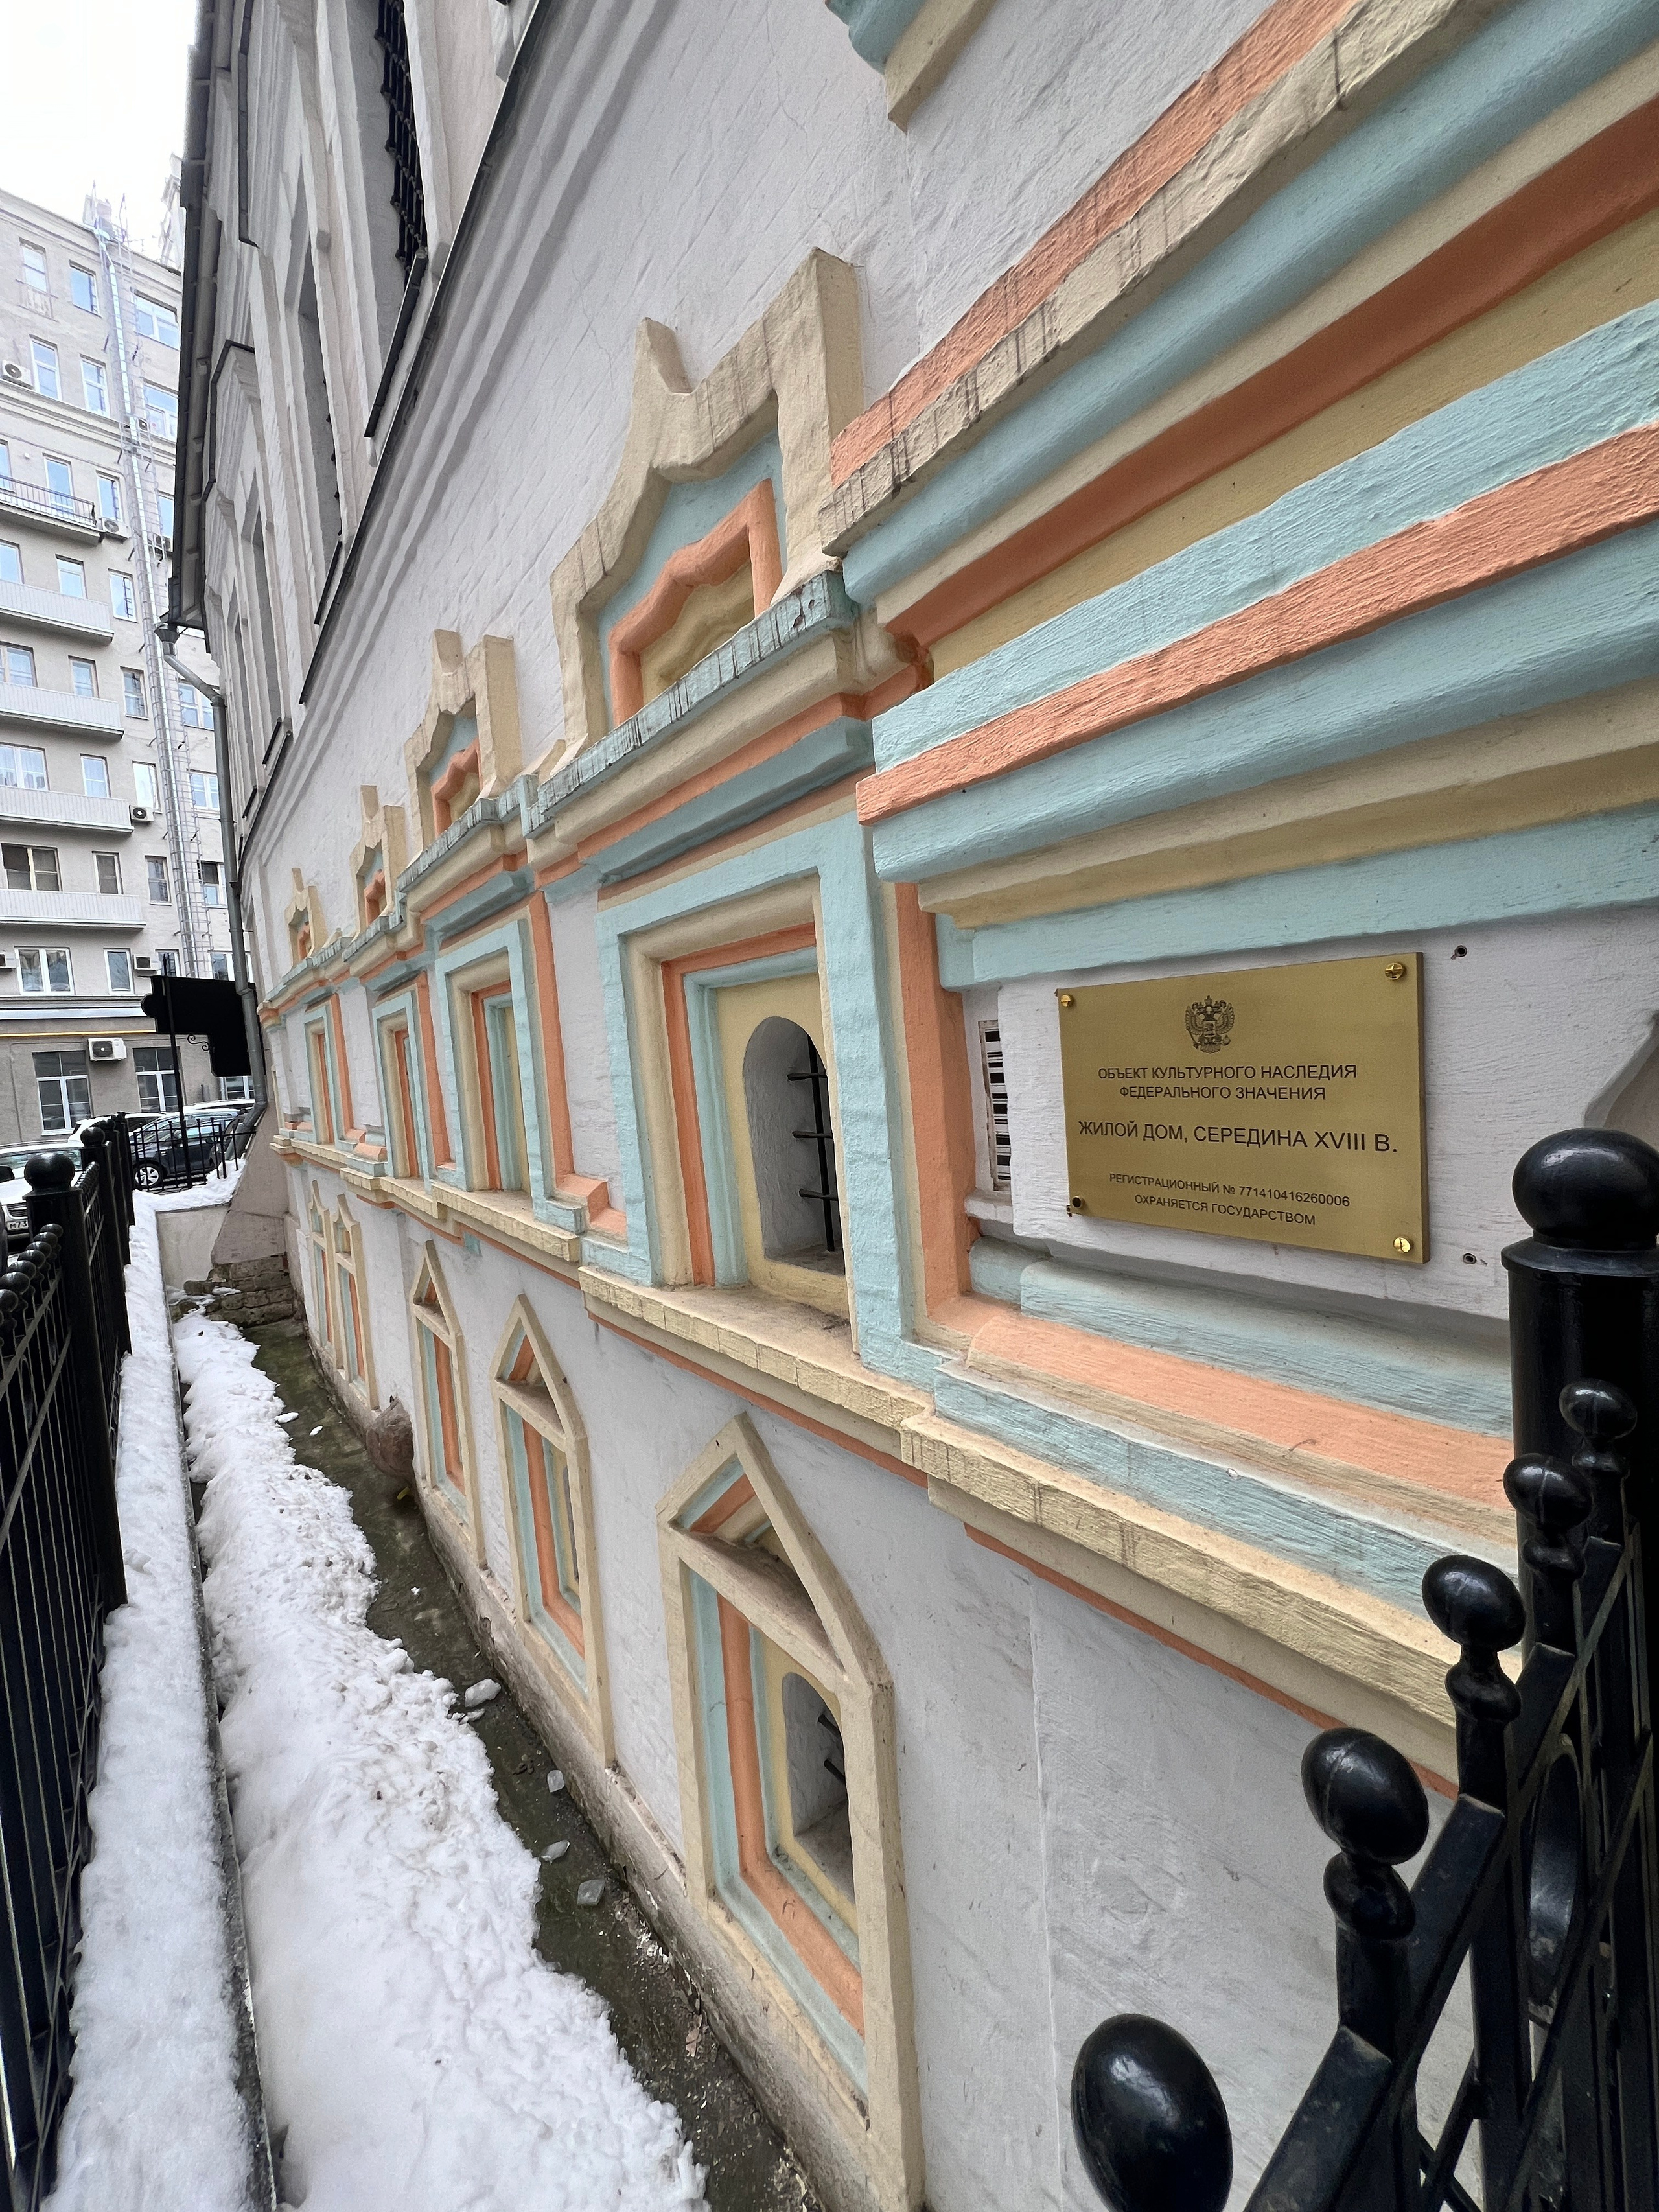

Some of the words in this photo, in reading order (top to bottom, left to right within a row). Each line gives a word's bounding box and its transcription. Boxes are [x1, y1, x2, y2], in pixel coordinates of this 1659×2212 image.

[1098, 1067, 1148, 1079] ОБЪЕКТ
[1152, 1066, 1256, 1079] КУЛЬТУРНОГО
[1261, 1065, 1356, 1080] НАСЛЕДИЯ
[1119, 1086, 1231, 1099] ФЕДЕРАЛЬНОГО
[1235, 1087, 1325, 1100] ЗНАЧЕНИЯ
[1078, 1120, 1139, 1137] ЖИЛОЙ
[1143, 1123, 1188, 1143] ДОМ,
[1193, 1126, 1308, 1148] СЕРЕДИНА
[1314, 1131, 1365, 1151] XVIII
[1375, 1134, 1397, 1152] В.
[1109, 1173, 1220, 1193] РЕГИСТРАЦИОННЫЙ
[1222, 1184, 1236, 1194] №
[1238, 1186, 1350, 1207] 771410416260006
[1135, 1194, 1208, 1212] ОХРАНЯЕТСЯ
[1211, 1204, 1316, 1225] ГОСУДАРСТВОМ
[10, 1220, 27, 1229] М73
